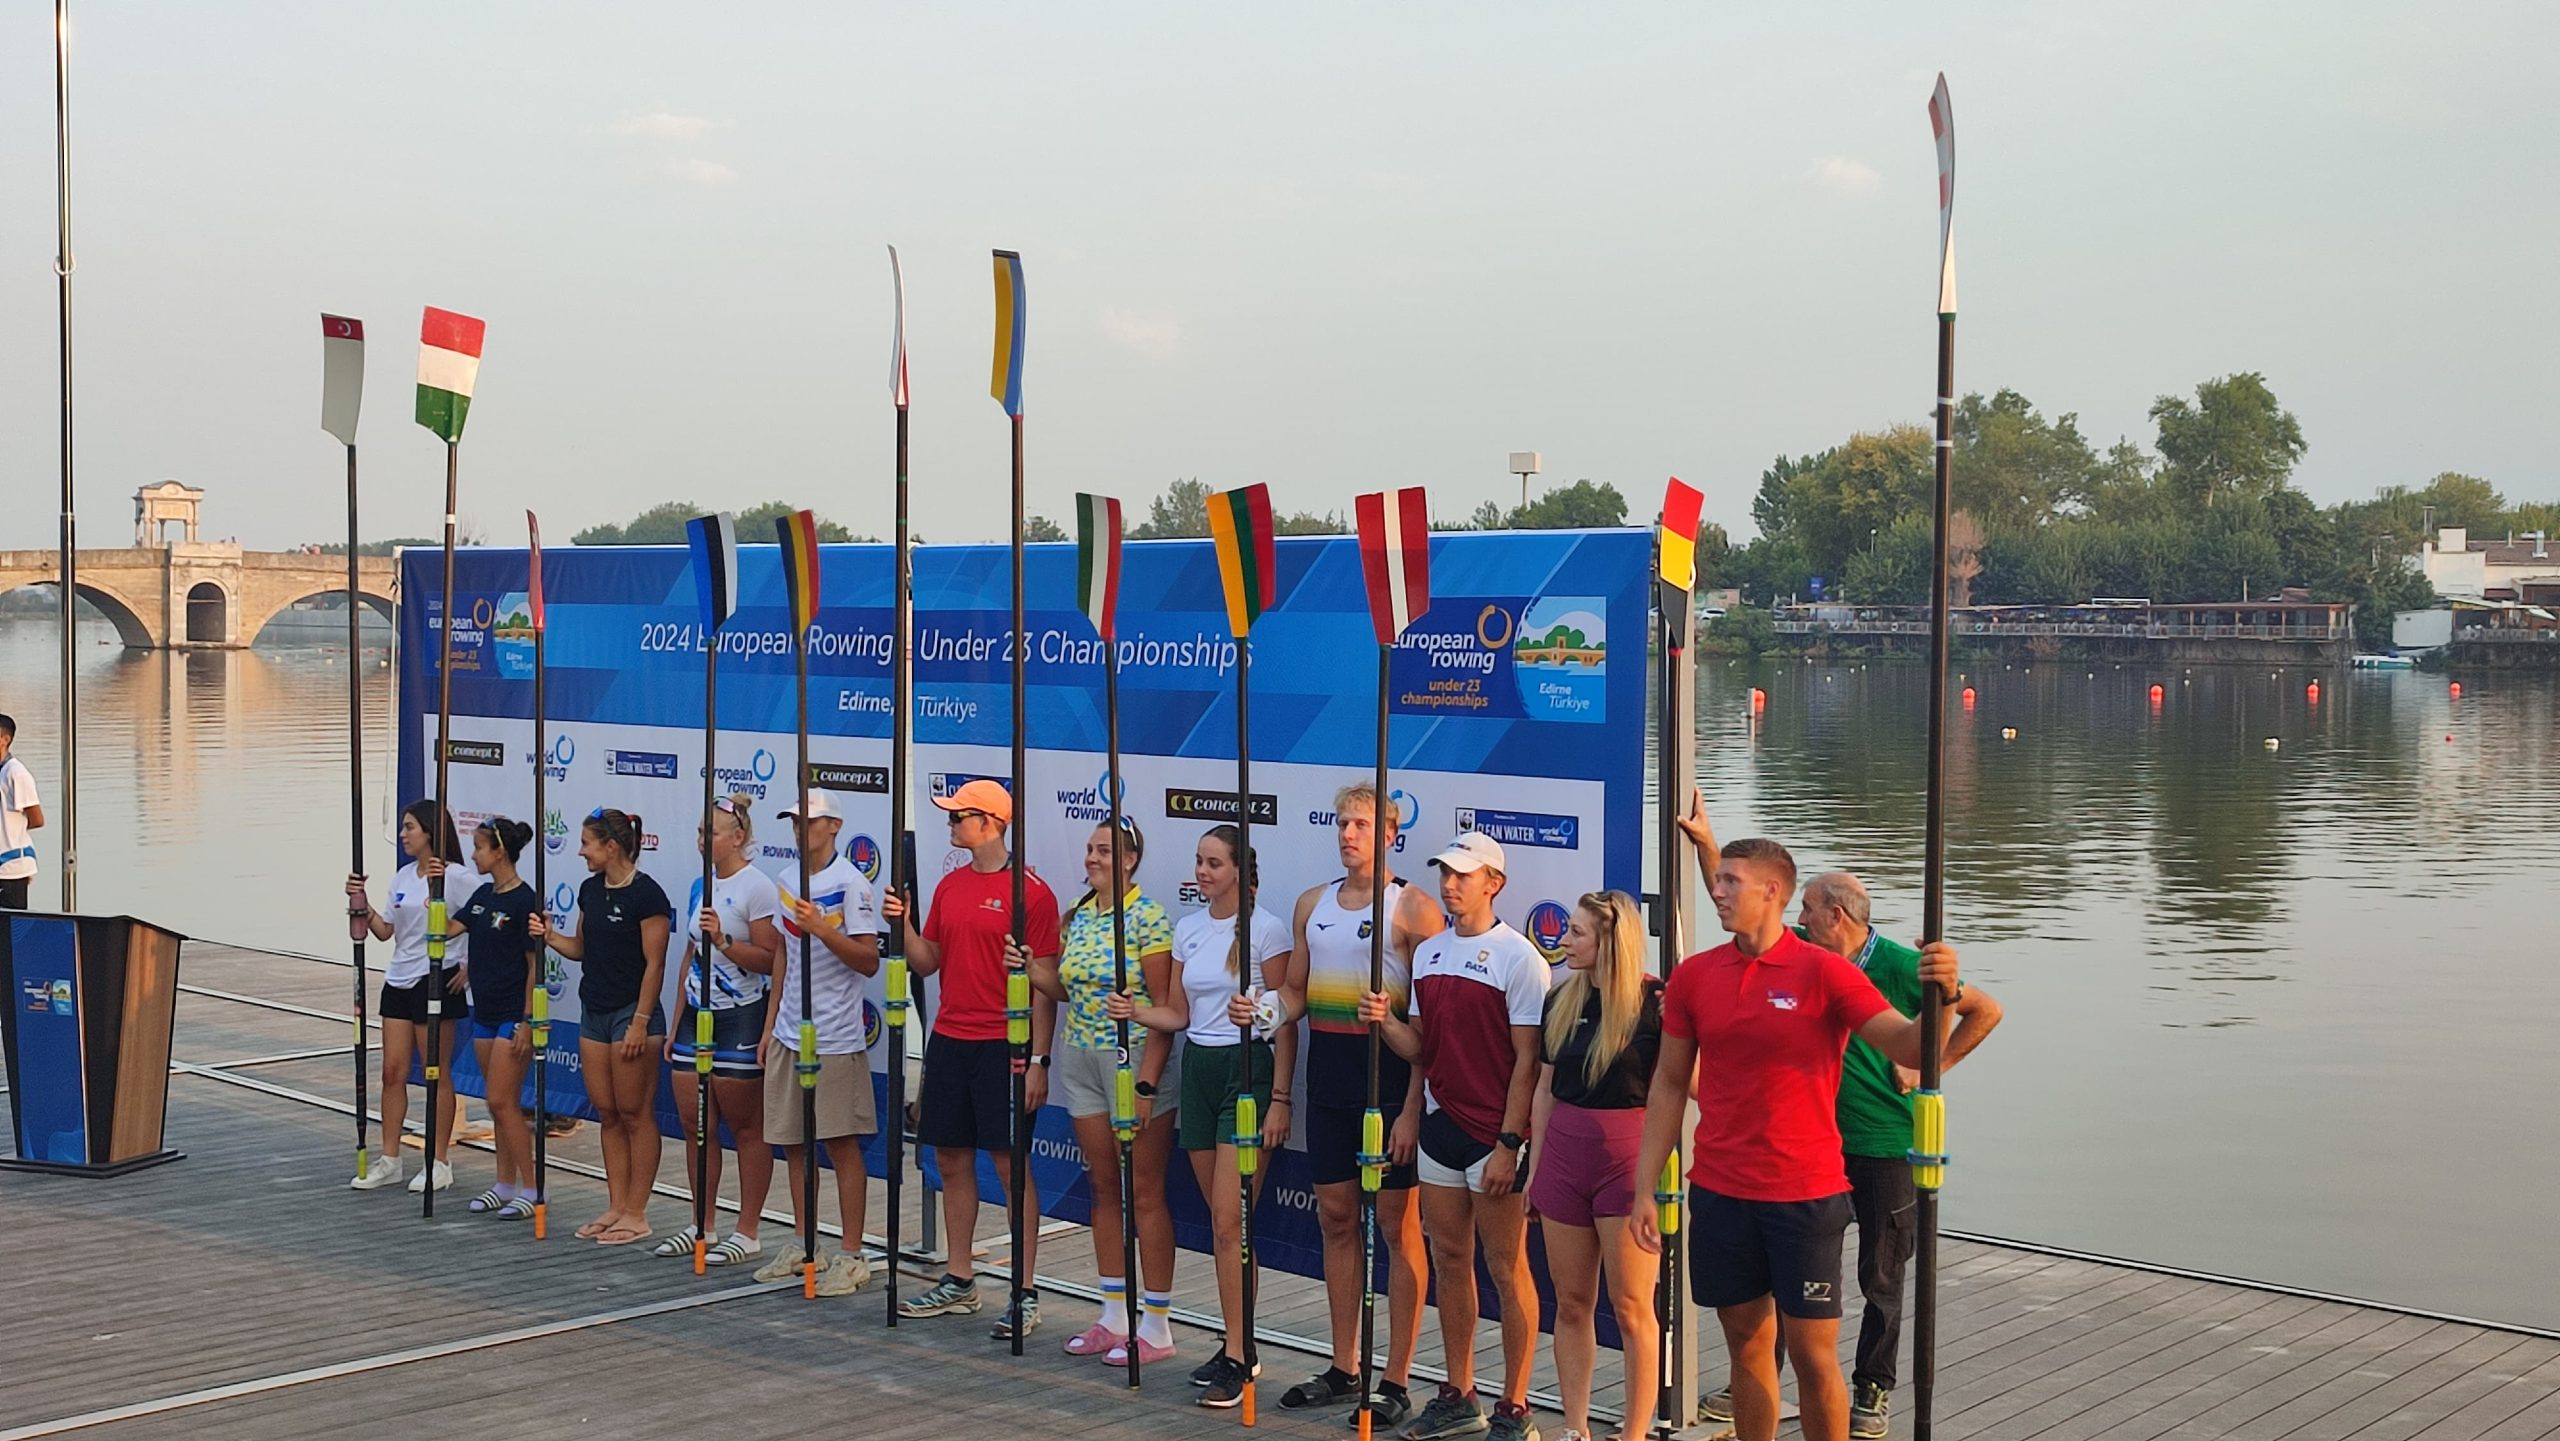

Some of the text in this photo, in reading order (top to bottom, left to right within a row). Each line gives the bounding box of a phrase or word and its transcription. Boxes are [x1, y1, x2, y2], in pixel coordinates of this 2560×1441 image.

[640, 622, 690, 651] 2024
[808, 624, 894, 666] Rowing
[919, 628, 998, 662] Under
[1001, 630, 1034, 663] 23
[1391, 632, 1475, 656] uropean
[1431, 650, 1496, 675] rowing
[1429, 679, 1481, 693] under 23
[1539, 682, 1572, 695] Edirne
[838, 690, 895, 716] Edirne,
[917, 695, 978, 724] Türkiye
[1401, 692, 1489, 711] championships
[1549, 694, 1591, 711] Türkiye
[494, 748, 501, 759] 2
[700, 767, 753, 783] eropean
[820, 770, 885, 785] concept 2
[728, 781, 767, 800] rowing
[1057, 787, 1096, 806] world
[1194, 798, 1271, 815] concet 2
[1504, 825, 1535, 843] WATER
